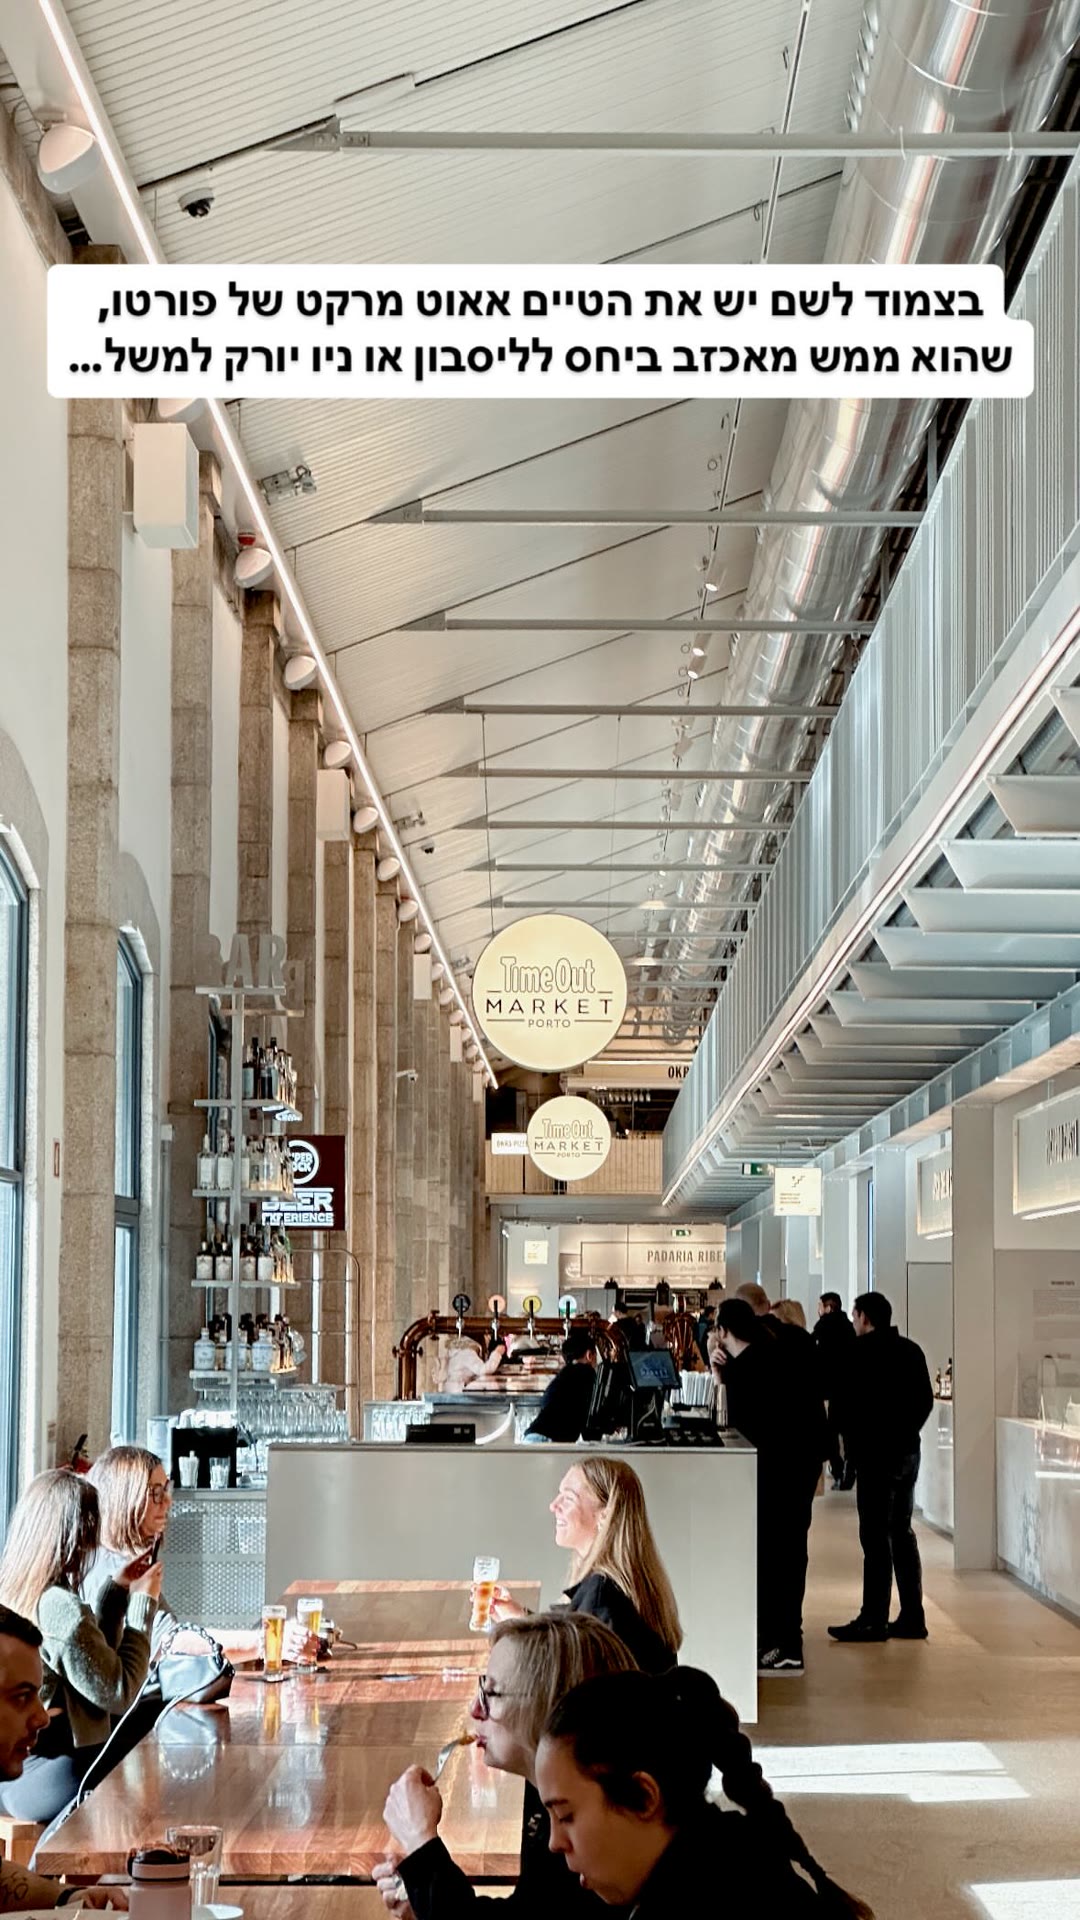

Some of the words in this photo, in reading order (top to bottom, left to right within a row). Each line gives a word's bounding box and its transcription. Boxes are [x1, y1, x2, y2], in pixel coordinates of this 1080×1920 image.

[486, 999, 613, 1014] MARKET
[528, 1019, 571, 1028] PORTO
[534, 1141, 604, 1152] MARKET
[647, 1250, 694, 1263] PADARIA
